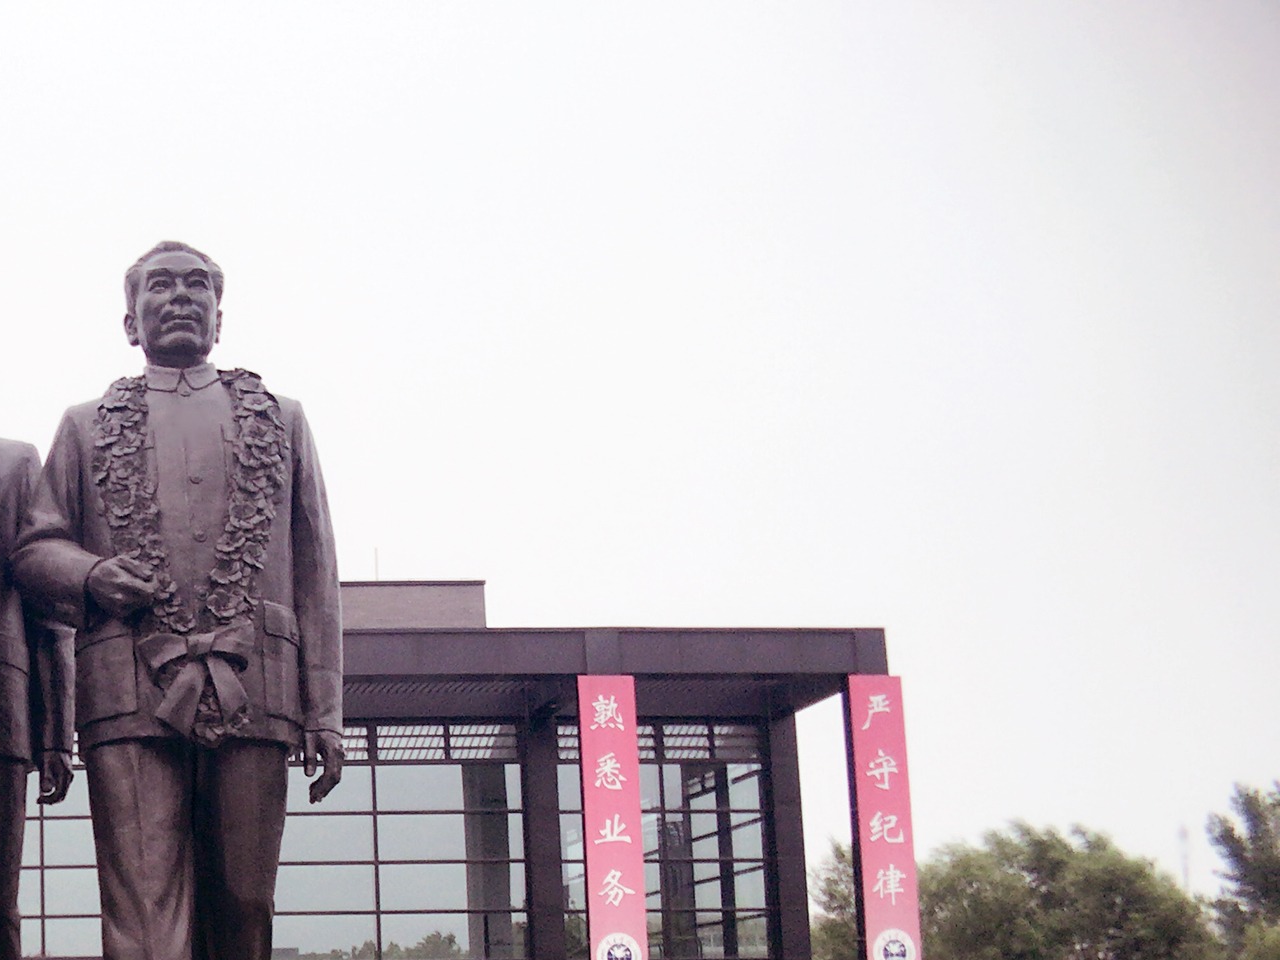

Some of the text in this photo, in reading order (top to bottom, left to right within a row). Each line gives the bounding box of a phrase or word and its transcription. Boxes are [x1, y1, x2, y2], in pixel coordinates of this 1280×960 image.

[589, 693, 636, 907] 熟悉业务
[861, 693, 907, 906] 严守纪律
